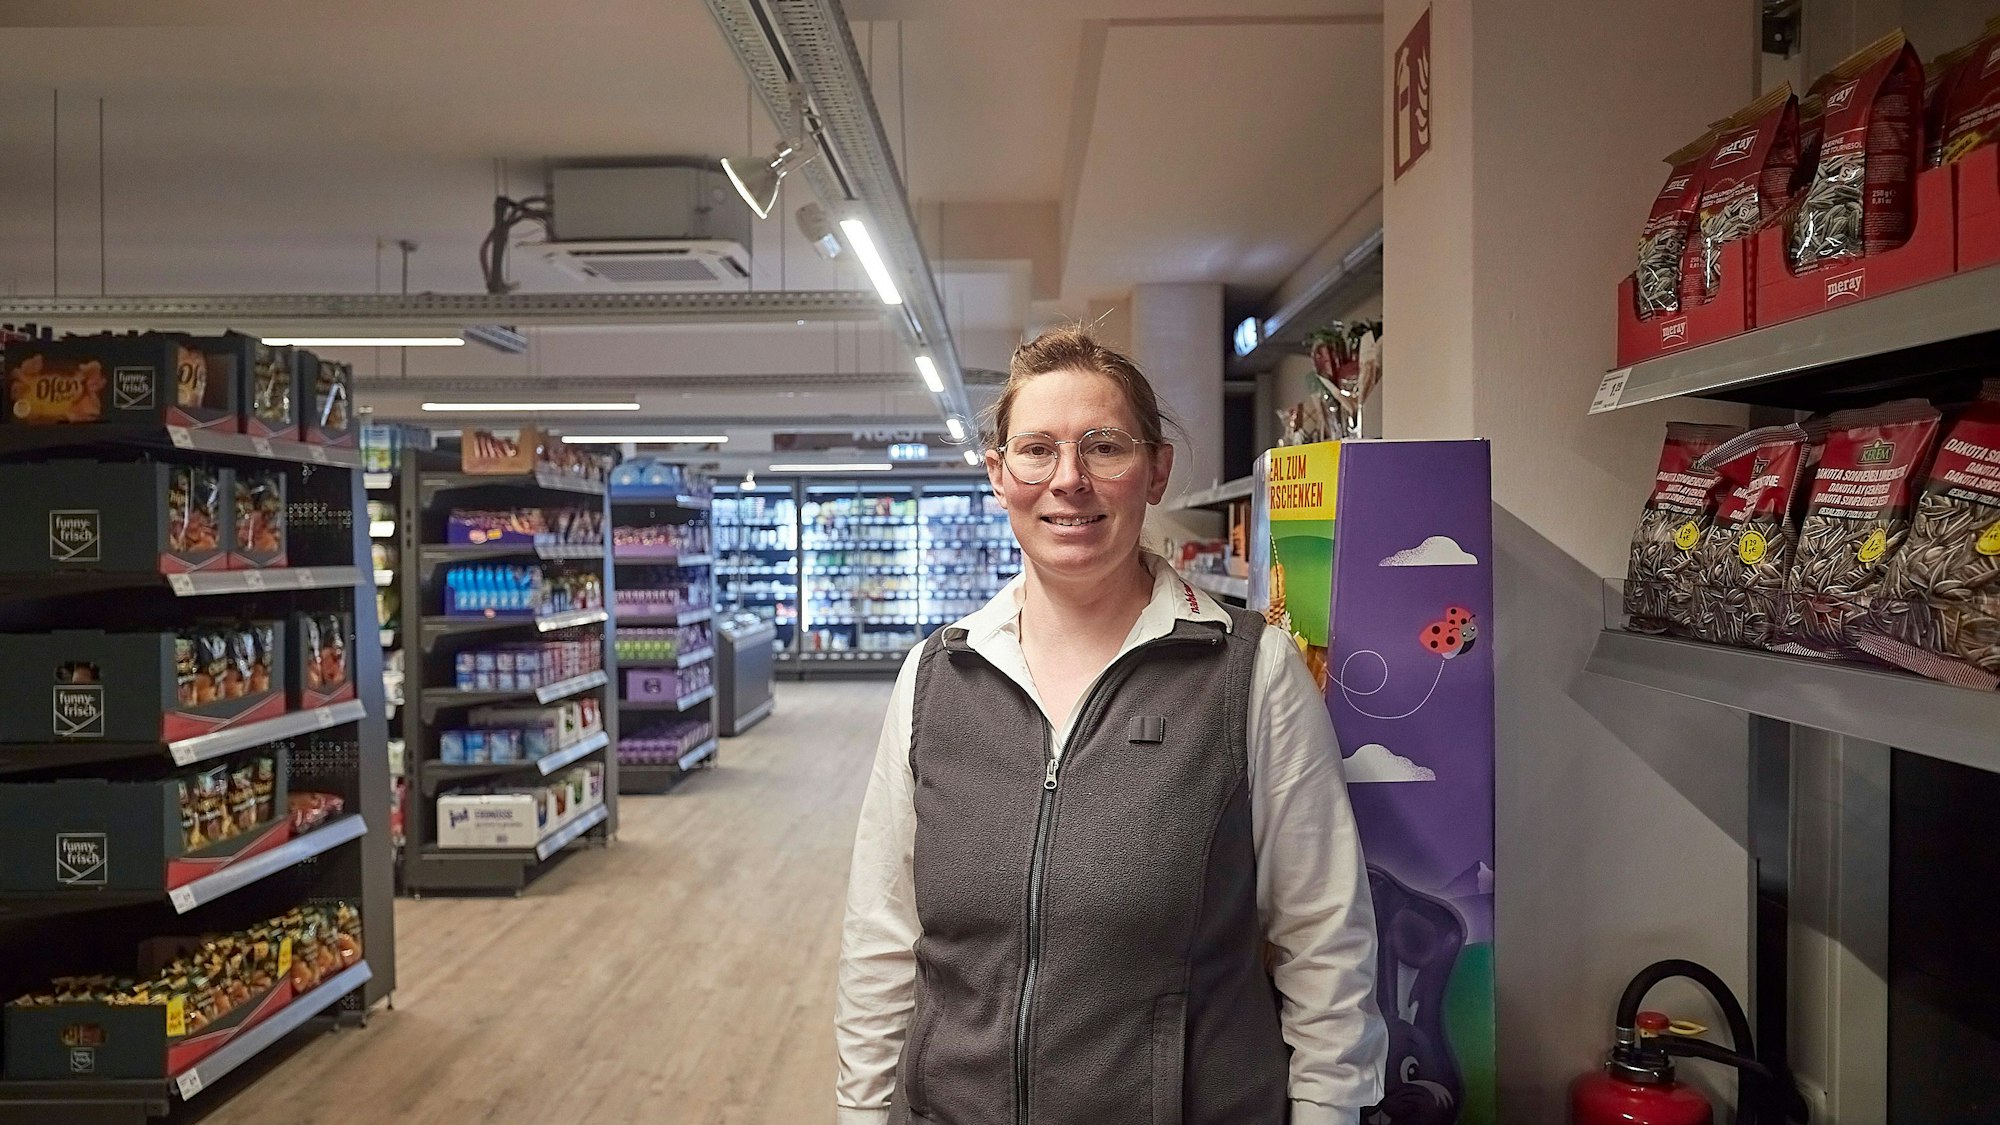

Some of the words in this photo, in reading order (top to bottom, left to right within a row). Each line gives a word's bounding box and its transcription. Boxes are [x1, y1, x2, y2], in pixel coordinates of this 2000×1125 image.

[1827, 275, 1863, 296] meray
[1662, 322, 1686, 338] meray
[1861, 447, 1891, 461] KEREM
[1943, 438, 1989, 461] DAKOTA
[1286, 454, 1307, 480] ZUM
[1815, 468, 1844, 480] DAKOTA
[1965, 461, 2000, 480] DAKOTA
[1943, 469, 1979, 489] DAKOTA
[1270, 482, 1323, 510] RSCHENKEN
[1828, 482, 1857, 495] DAKOTA
[1814, 492, 1842, 505] DAKOTA
[55, 516, 91, 532] funny-
[60, 527, 93, 542] frisch
[59, 690, 95, 706] funny-
[64, 702, 97, 717] frisch
[62, 838, 99, 853] funny-
[67, 850, 100, 865] frisch
